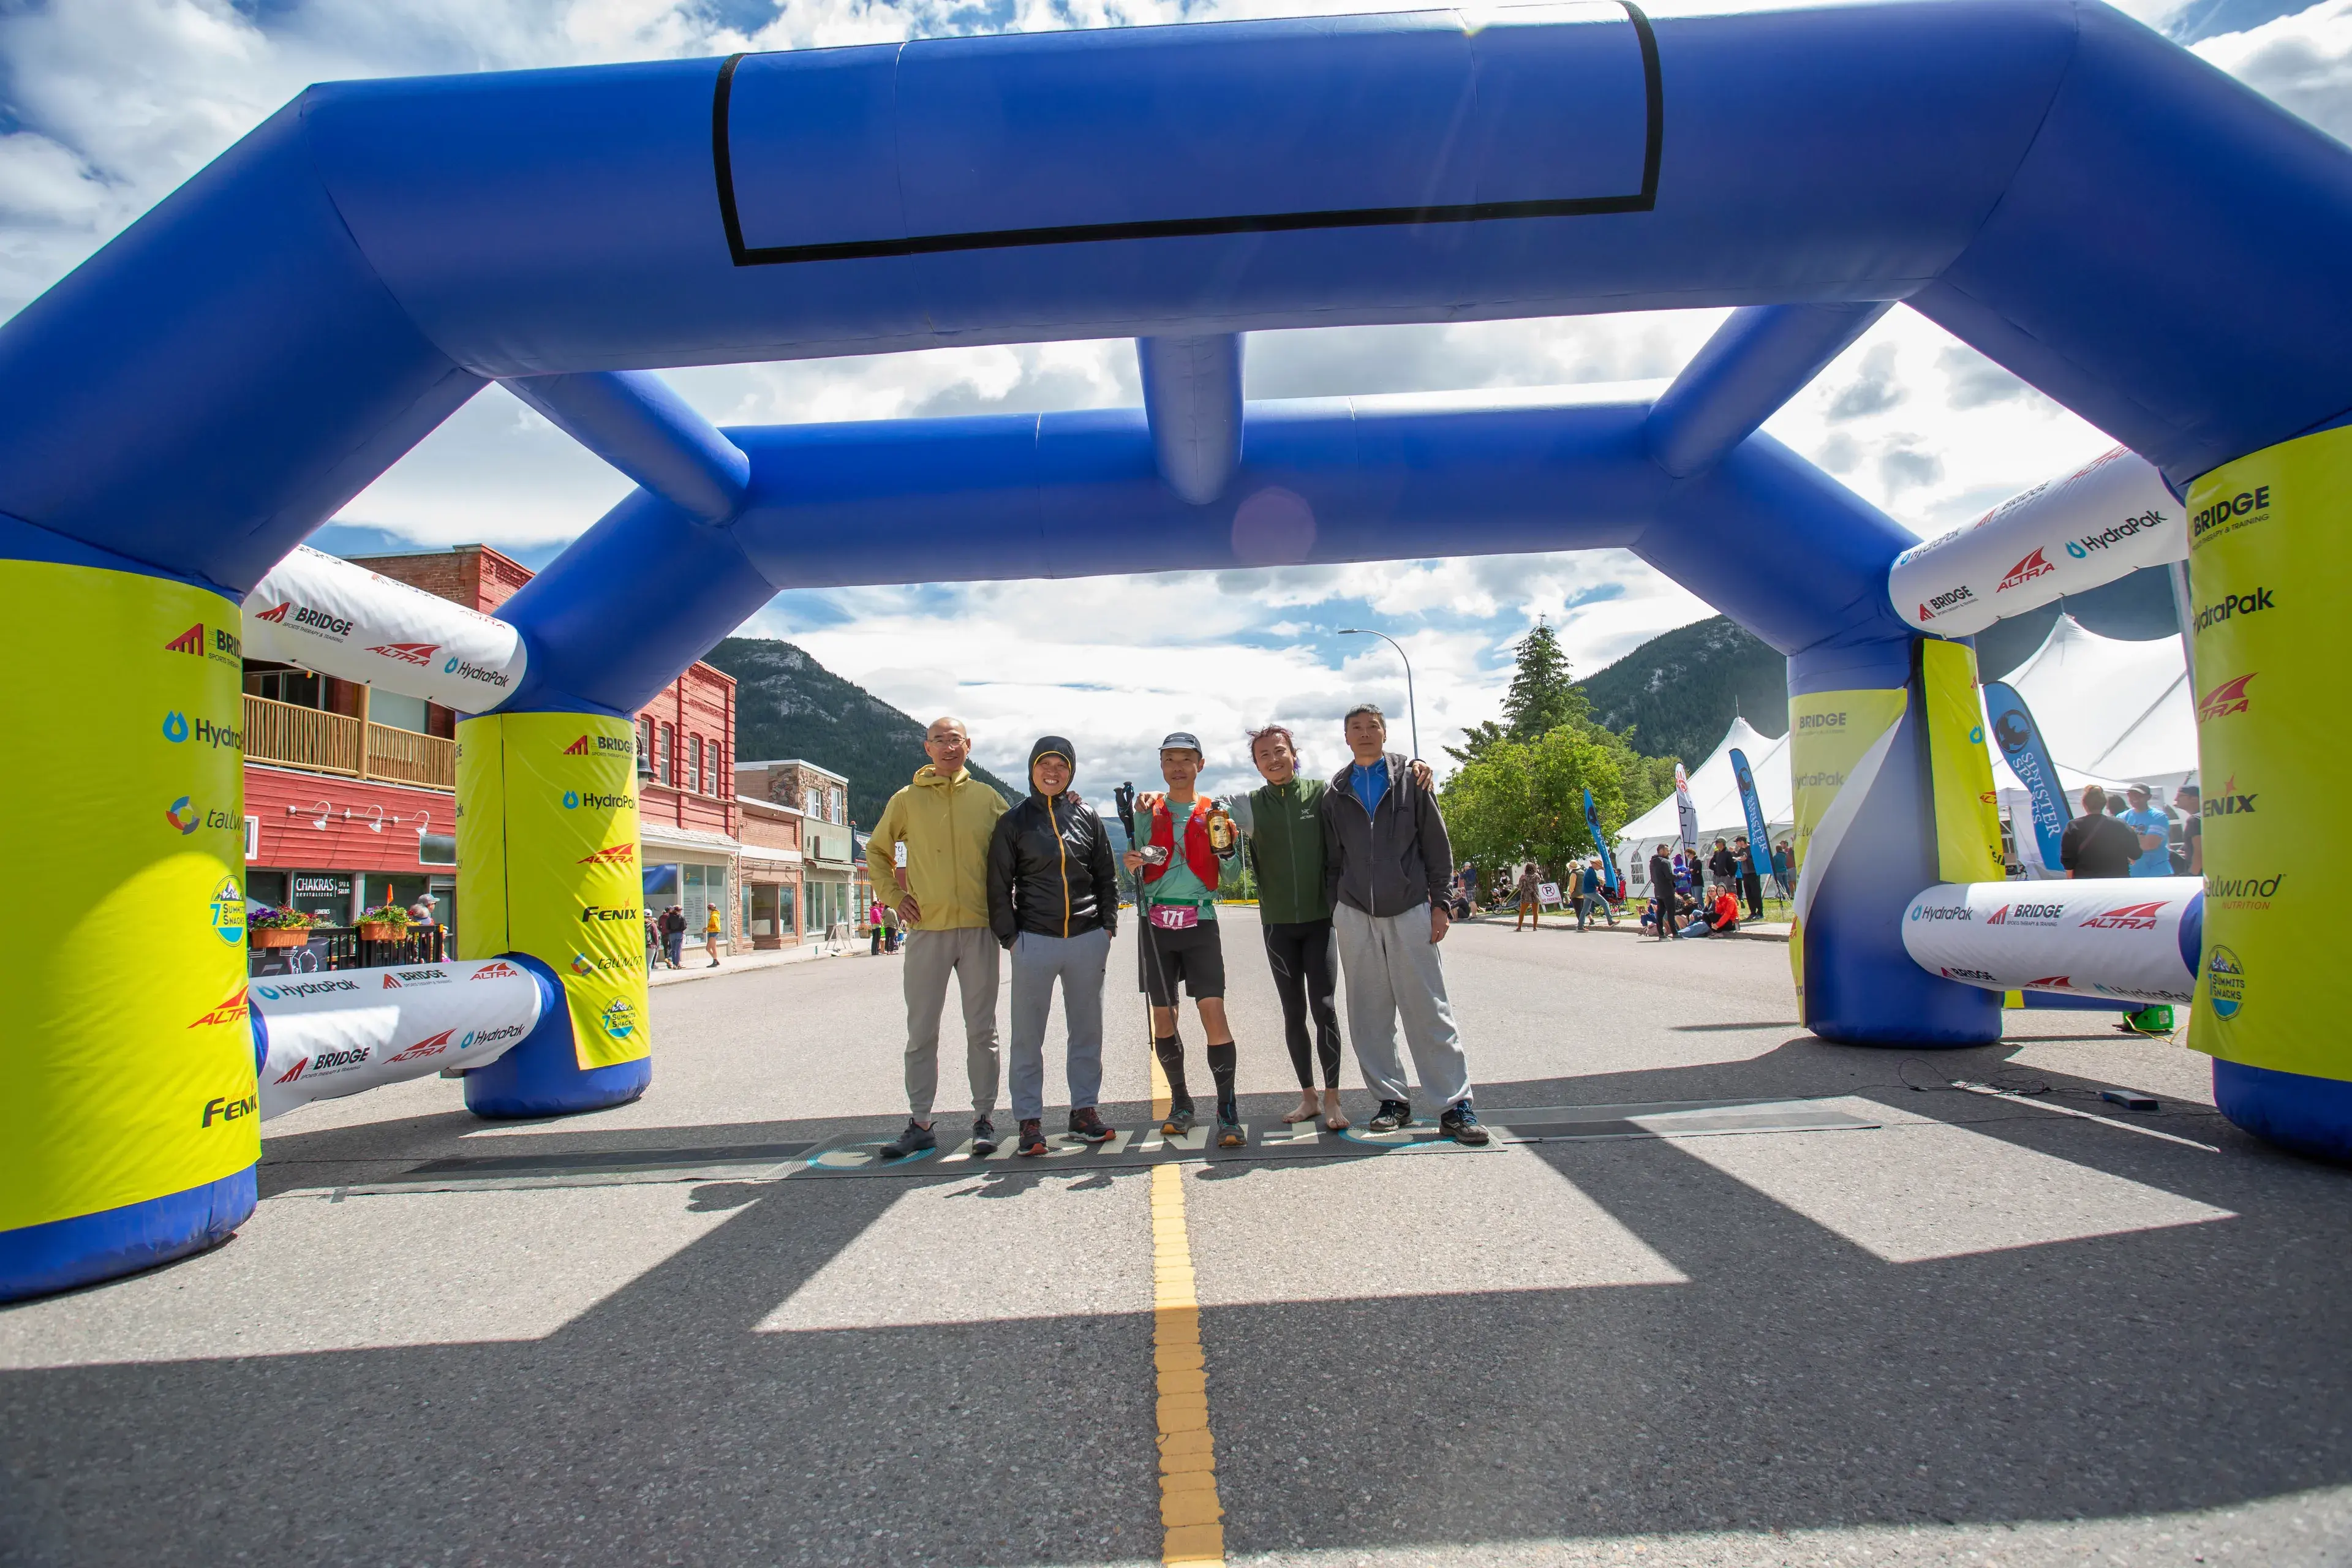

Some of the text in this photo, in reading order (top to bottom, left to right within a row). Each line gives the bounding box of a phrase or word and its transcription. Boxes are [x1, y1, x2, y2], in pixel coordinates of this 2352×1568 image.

[2002, 480, 2051, 511] BRIDGE
[2194, 486, 2269, 537] BRIDGE
[2081, 510, 2168, 551] HydraPak
[2231, 514, 2270, 532] TRAINING
[1996, 563, 2056, 593] ALTRA
[1930, 585, 1973, 609] BRIDGE
[295, 606, 353, 636] BRIDGE
[300, 627, 320, 636] THERAPY
[323, 633, 344, 644] TRAINING
[364, 646, 431, 666] ALTRA
[458, 662, 510, 687] HydraPak
[1800, 712, 1847, 729] BRIDGE
[583, 793, 637, 810] HydraPak
[2021, 752, 2061, 839] SINISTER
[1750, 796, 1768, 853] SINISTER
[296, 878, 334, 891] CHAKRAS
[209, 903, 221, 925] 7
[1922, 907, 1973, 922] HydraPak
[2014, 904, 2064, 918] BRIDGE
[2222, 900, 2271, 910] NUTRITION
[1161, 910, 1185, 927] 171
[2078, 918, 2157, 930] ALTRA
[398, 970, 448, 981] BRIDGE
[470, 970, 519, 981] ALTRA
[1951, 968, 1998, 981] BRIDGE
[276, 979, 361, 998] HydraPak
[602, 1015, 611, 1030] 7
[473, 1024, 526, 1046] HydraPak
[313, 1047, 371, 1071] BRIDGE
[381, 1046, 448, 1065] ALTRA
